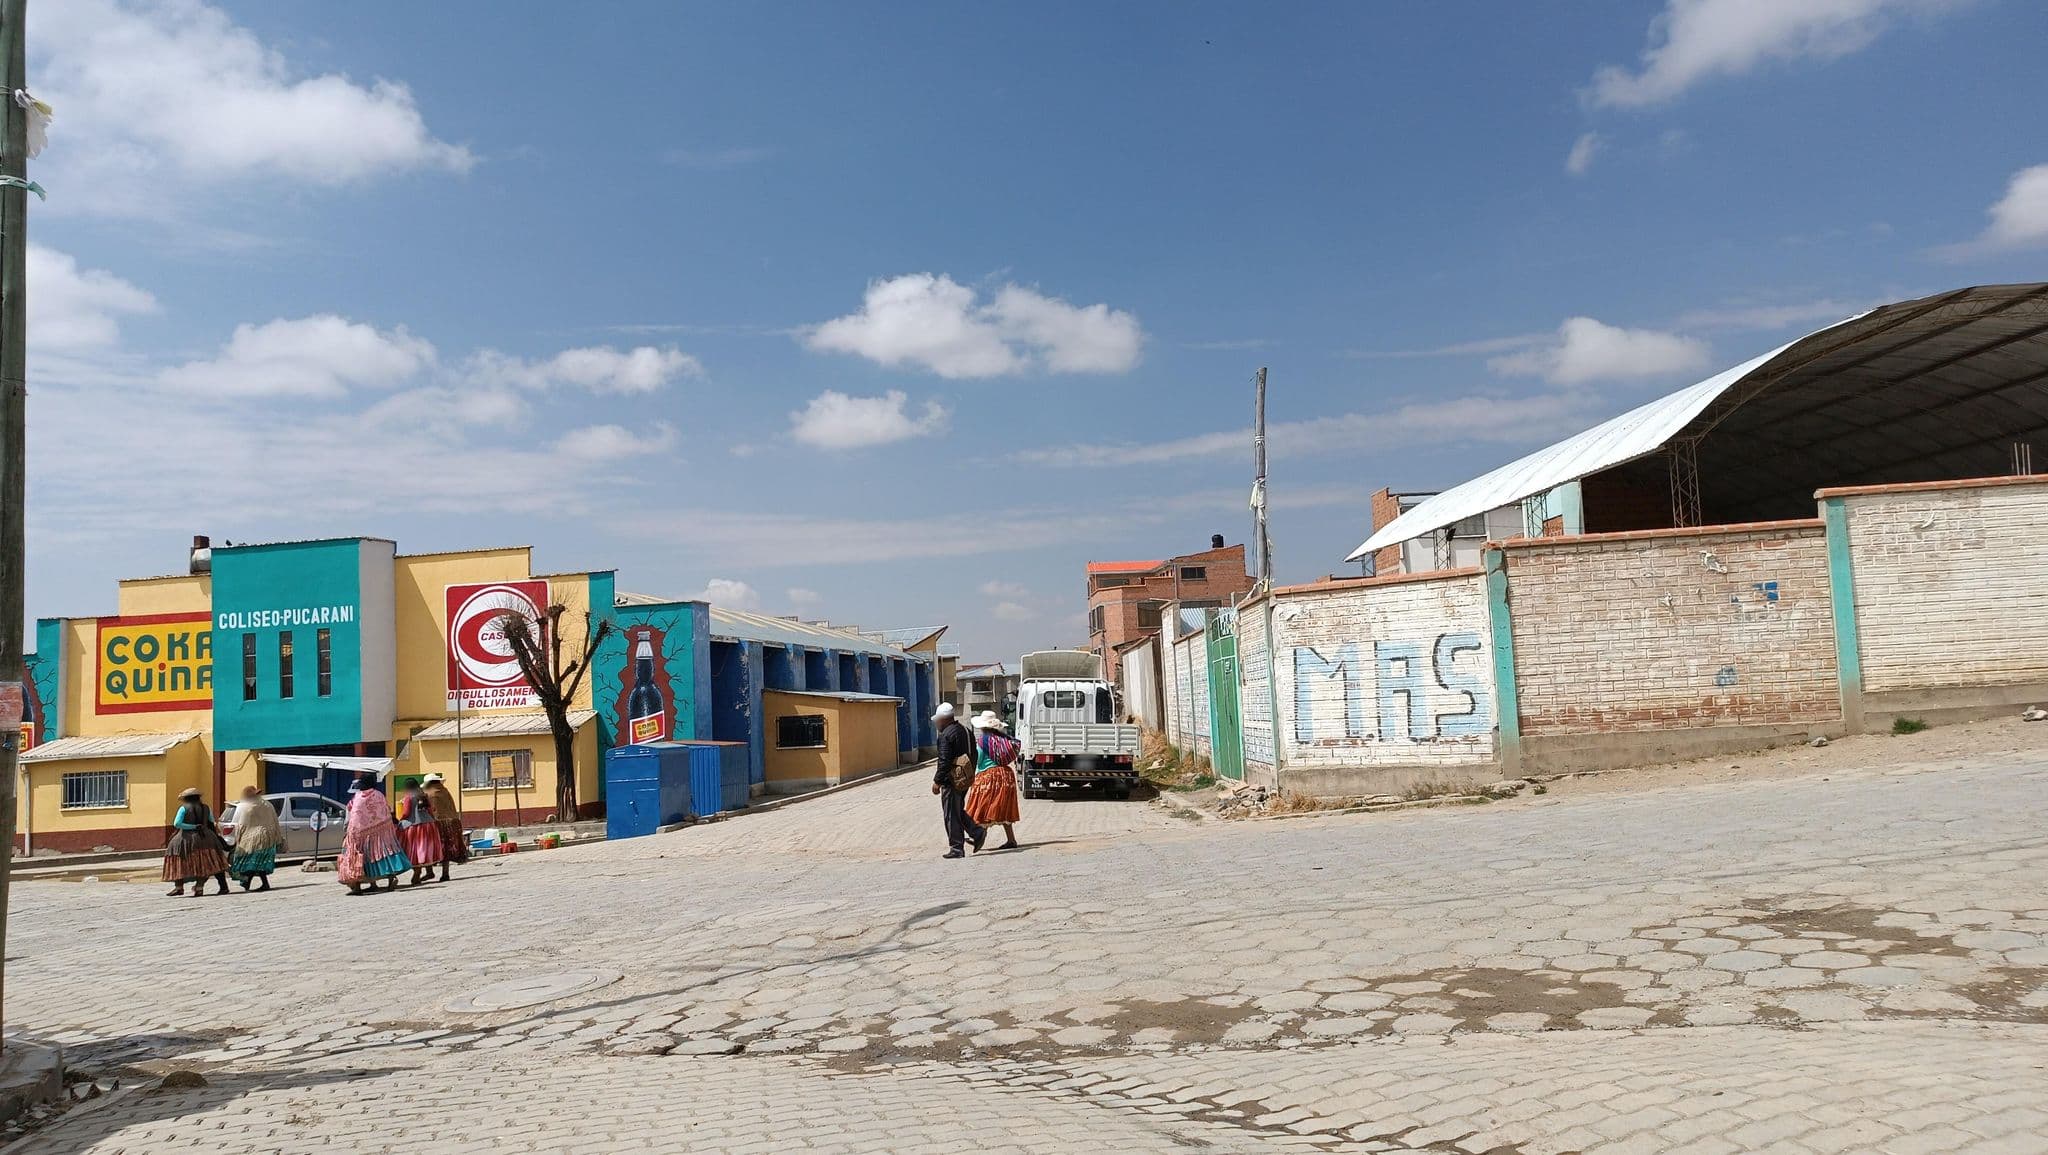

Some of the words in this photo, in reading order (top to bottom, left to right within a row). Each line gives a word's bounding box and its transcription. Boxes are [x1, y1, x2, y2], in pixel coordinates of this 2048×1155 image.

[218, 605, 354, 630] COLISEO-PUCARANI
[106, 631, 213, 665] COKA
[447, 687, 538, 700] ORGULLOSAMEN
[1292, 631, 1491, 745] MAS
[468, 697, 527, 708] BOLIVIANA
